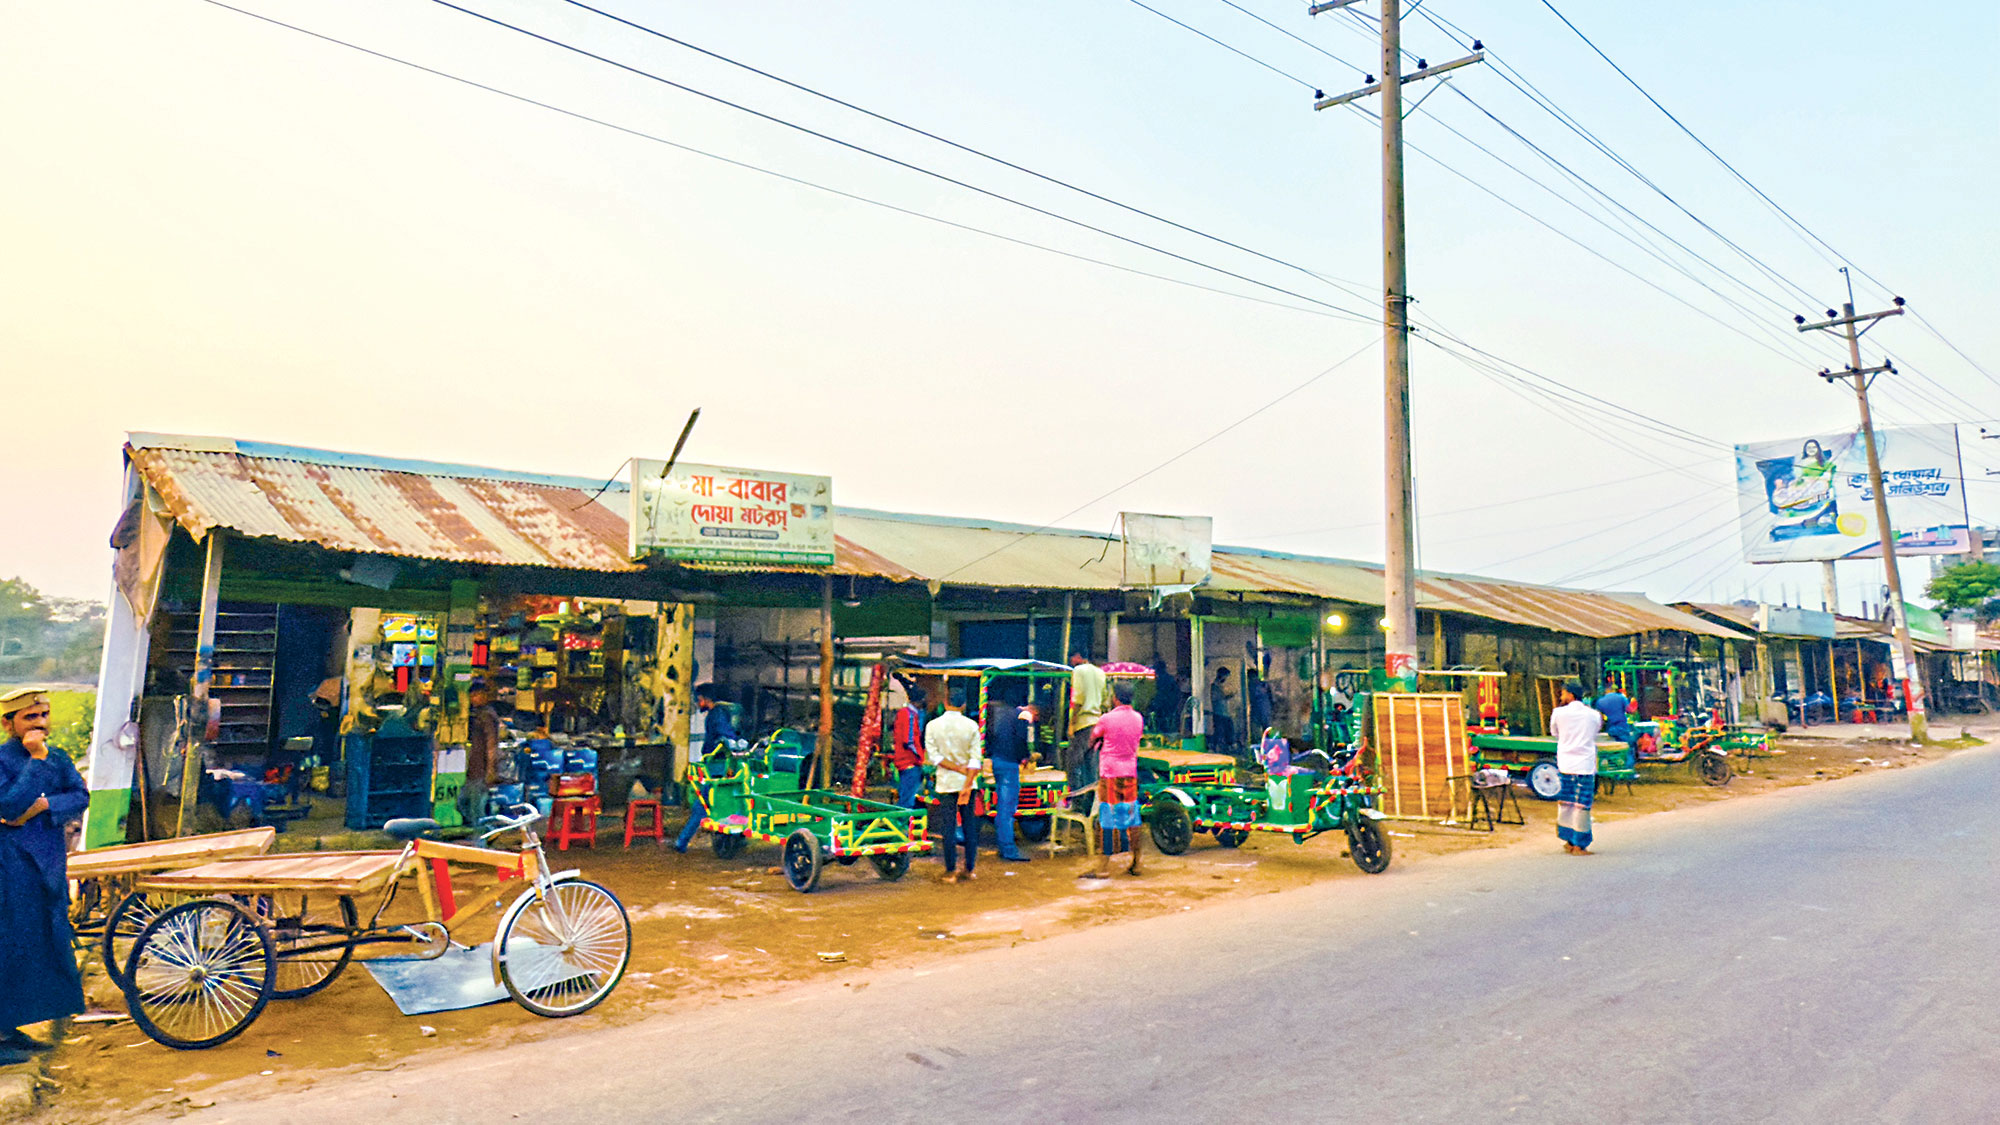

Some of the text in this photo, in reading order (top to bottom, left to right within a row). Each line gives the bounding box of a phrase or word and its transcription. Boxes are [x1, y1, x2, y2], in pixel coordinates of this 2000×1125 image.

[691, 475, 787, 505] মা-বাবার
[691, 504, 787, 531] দোয়া মটরস্
